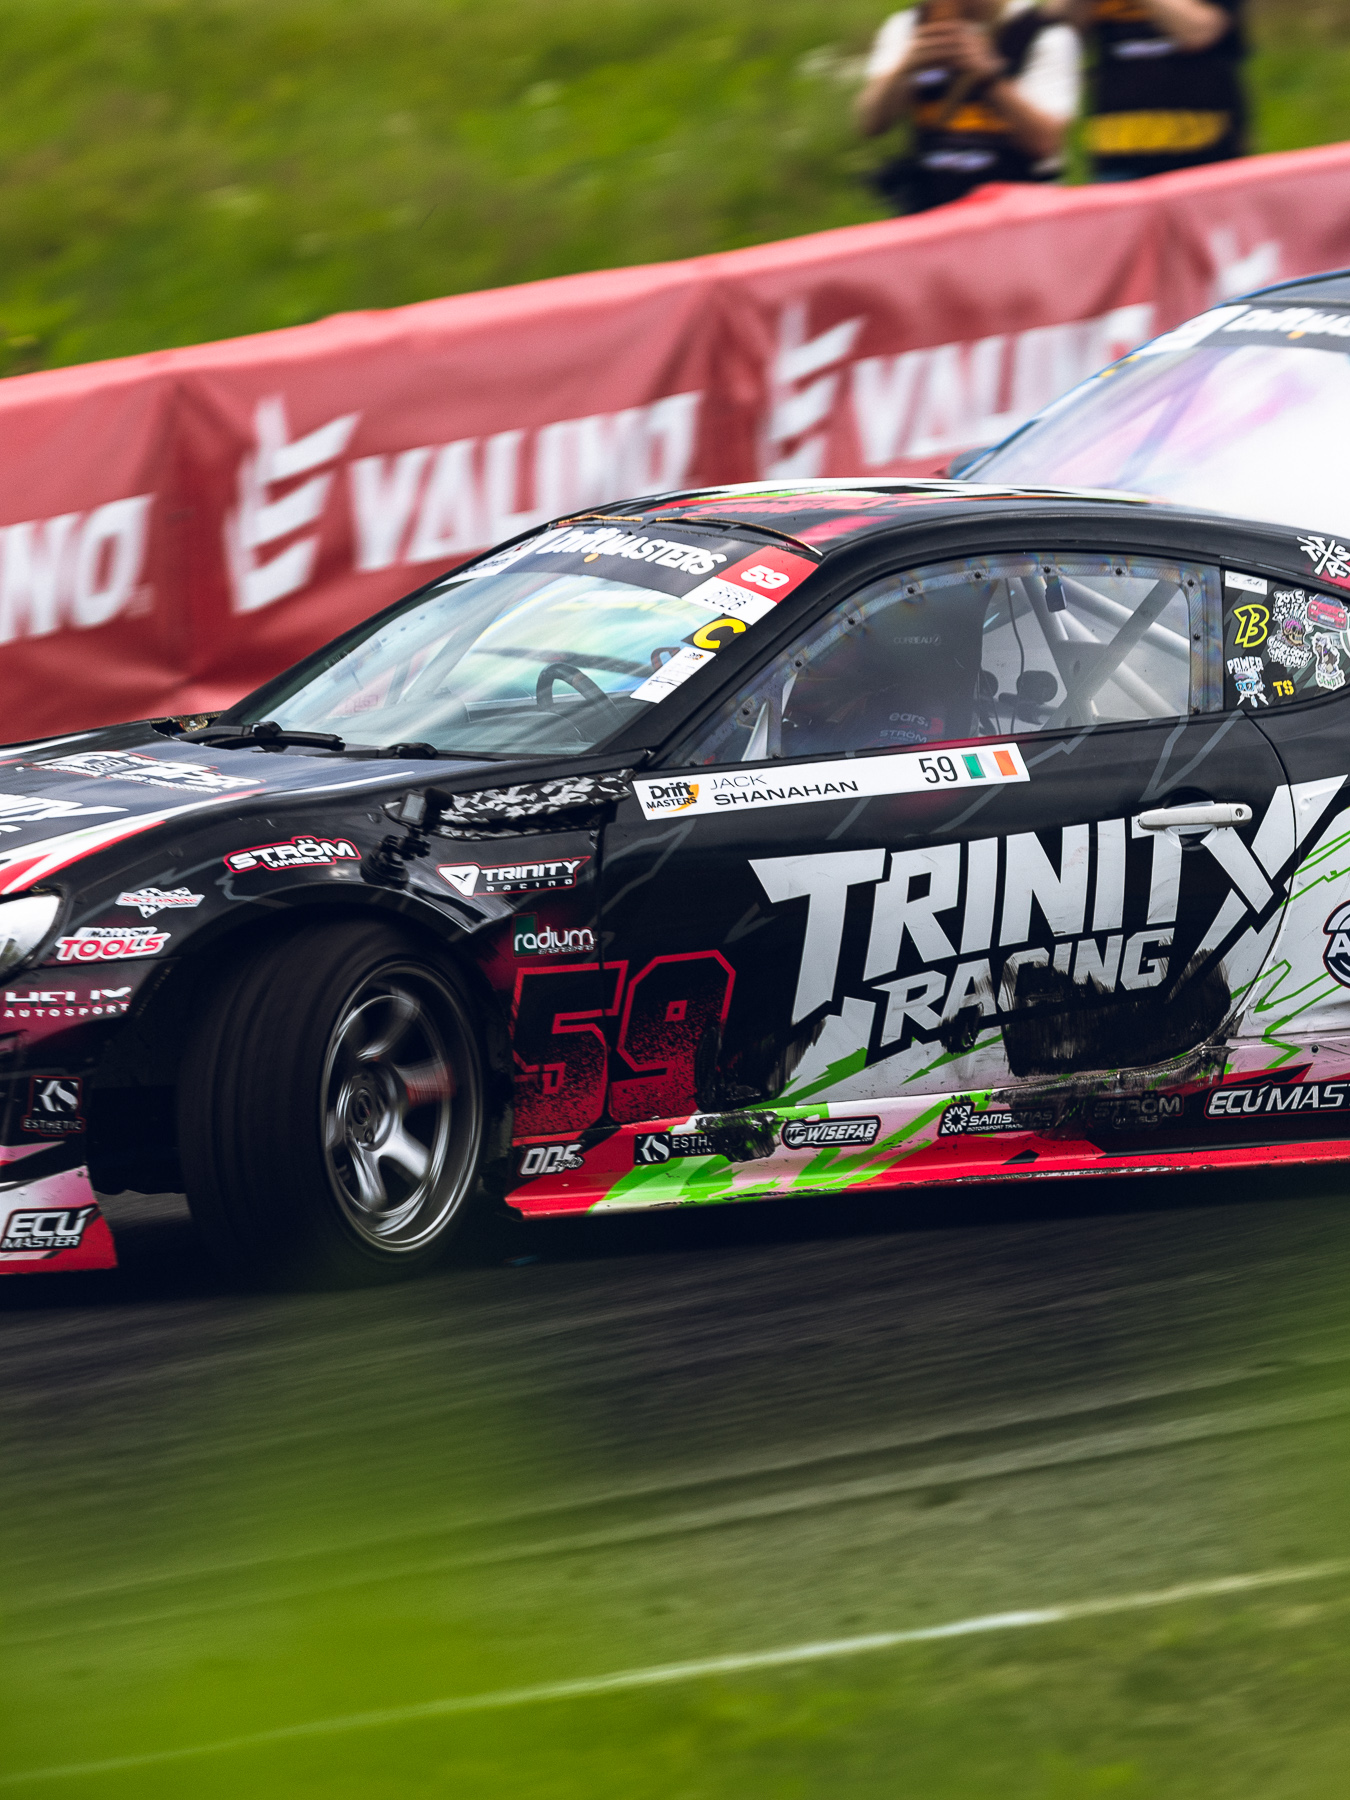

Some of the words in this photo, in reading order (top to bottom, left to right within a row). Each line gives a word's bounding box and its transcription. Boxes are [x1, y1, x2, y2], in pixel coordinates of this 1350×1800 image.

[606, 532, 728, 575] MASTERS
[741, 564, 790, 589] 59
[693, 618, 747, 649] C
[709, 774, 768, 790] JACK
[918, 755, 959, 785] 59
[650, 782, 695, 800] Drift
[713, 780, 859, 806] SHANAHAN
[646, 797, 697, 811] MASTERS
[229, 839, 356, 870] STRÖM
[481, 860, 580, 882] TRINITY
[747, 774, 1346, 1030] TRINITY
[61, 936, 165, 957] TOOLS
[514, 925, 595, 951] radium
[870, 928, 1176, 1047] RACING
[3, 1003, 130, 1018] AUTOSPORT
[511, 950, 736, 1138] 59
[23, 1119, 82, 1130] ESTHETIC
[804, 1123, 878, 1142] WISEFAB
[1, 1235, 81, 1249] MASTER
